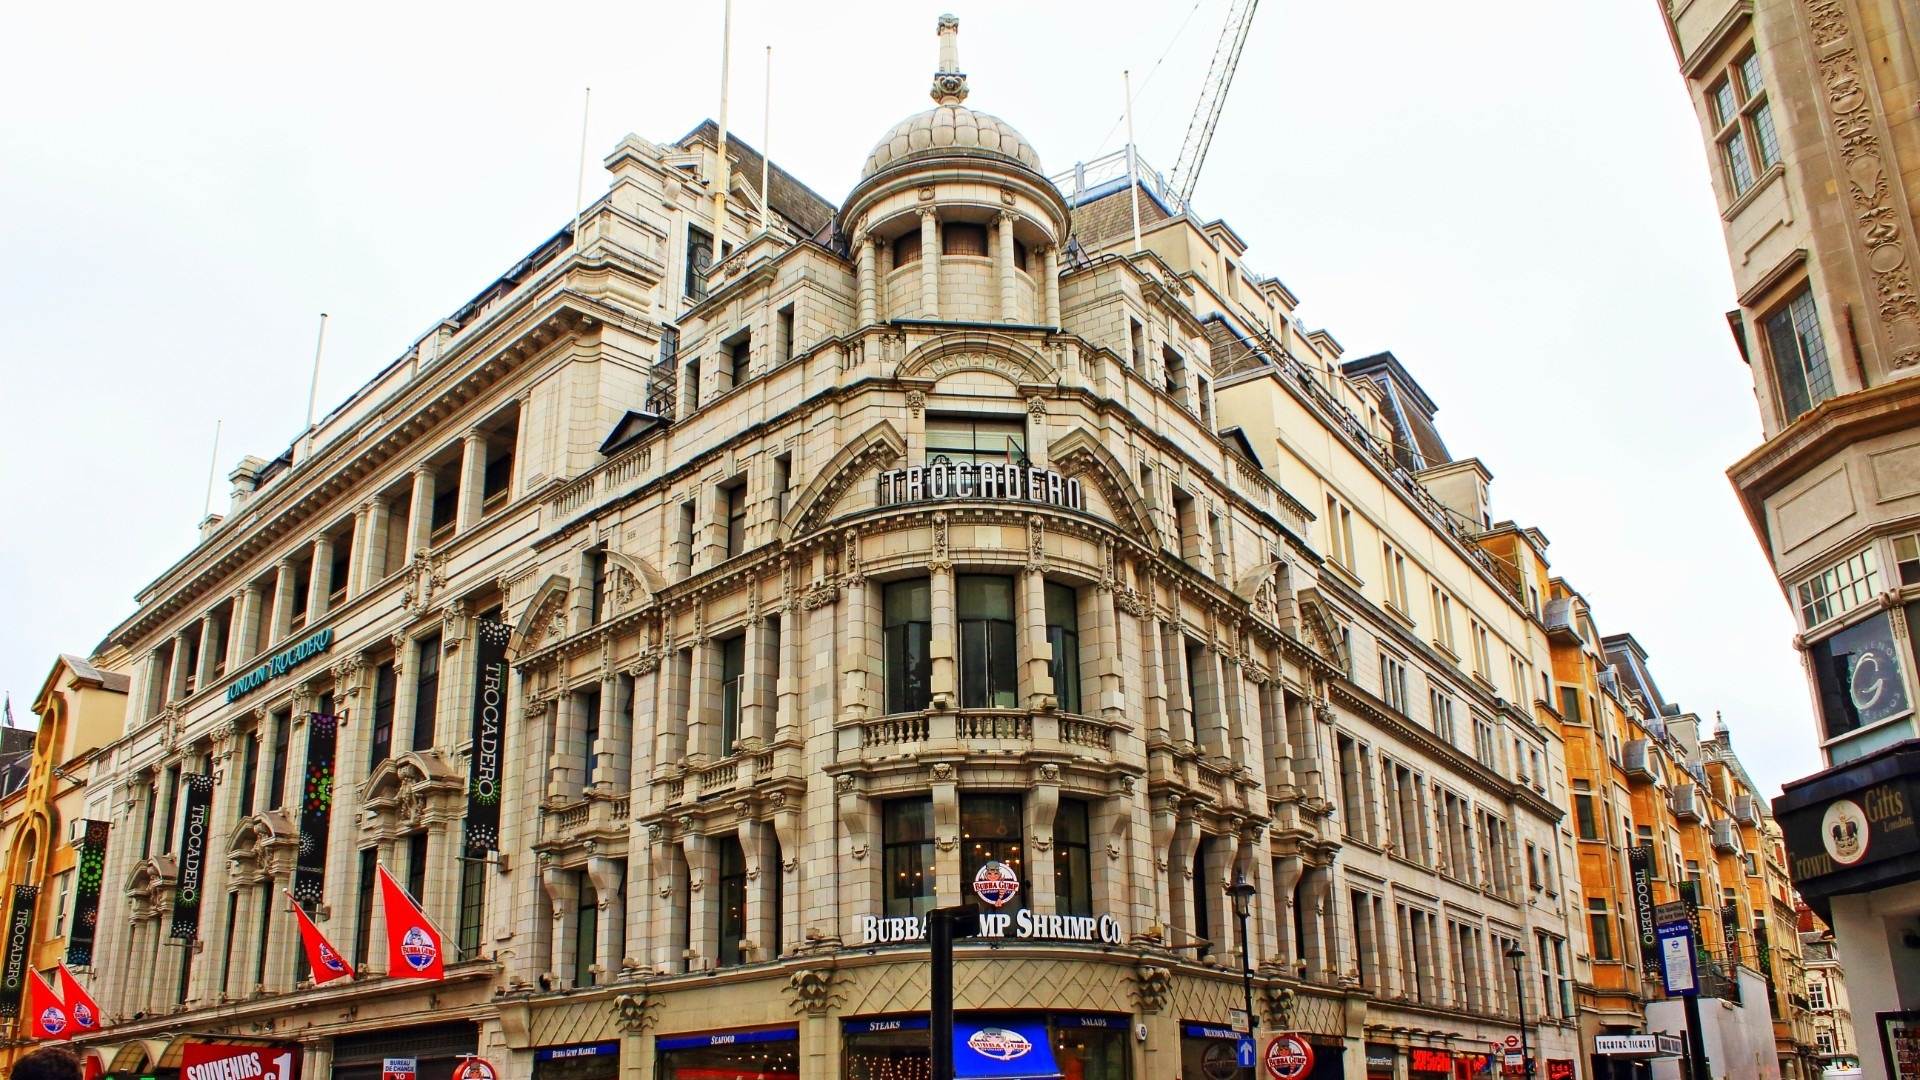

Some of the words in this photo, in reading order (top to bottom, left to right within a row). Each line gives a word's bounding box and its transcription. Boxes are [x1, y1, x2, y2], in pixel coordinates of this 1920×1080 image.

[883, 462, 1081, 509] TROCADERO
[227, 664, 269, 702] LONDON
[267, 628, 332, 680] TROCADERO
[478, 663, 502, 797] TROCADERO
[1865, 785, 1904, 823] Gifts
[182, 804, 205, 902] TROCADERO
[1788, 852, 1833, 881] Crown
[975, 882, 997, 890] BUBBA
[999, 881, 1019, 890] GUMP
[1635, 868, 1654, 945] TROCADERO
[976, 914, 1010, 938] MP
[1017, 908, 1097, 940] SHRIMP
[6, 908, 29, 988] TROCADERO
[869, 1020, 901, 1031] STEAKS
[1081, 1017, 1107, 1027] SALADS
[710, 1035, 735, 1045] SEAFOOD
[969, 1041, 1001, 1049] BUBBA
[1003, 1042, 1031, 1050] GUMP
[186, 1051, 262, 1080] SOUVENIRS
